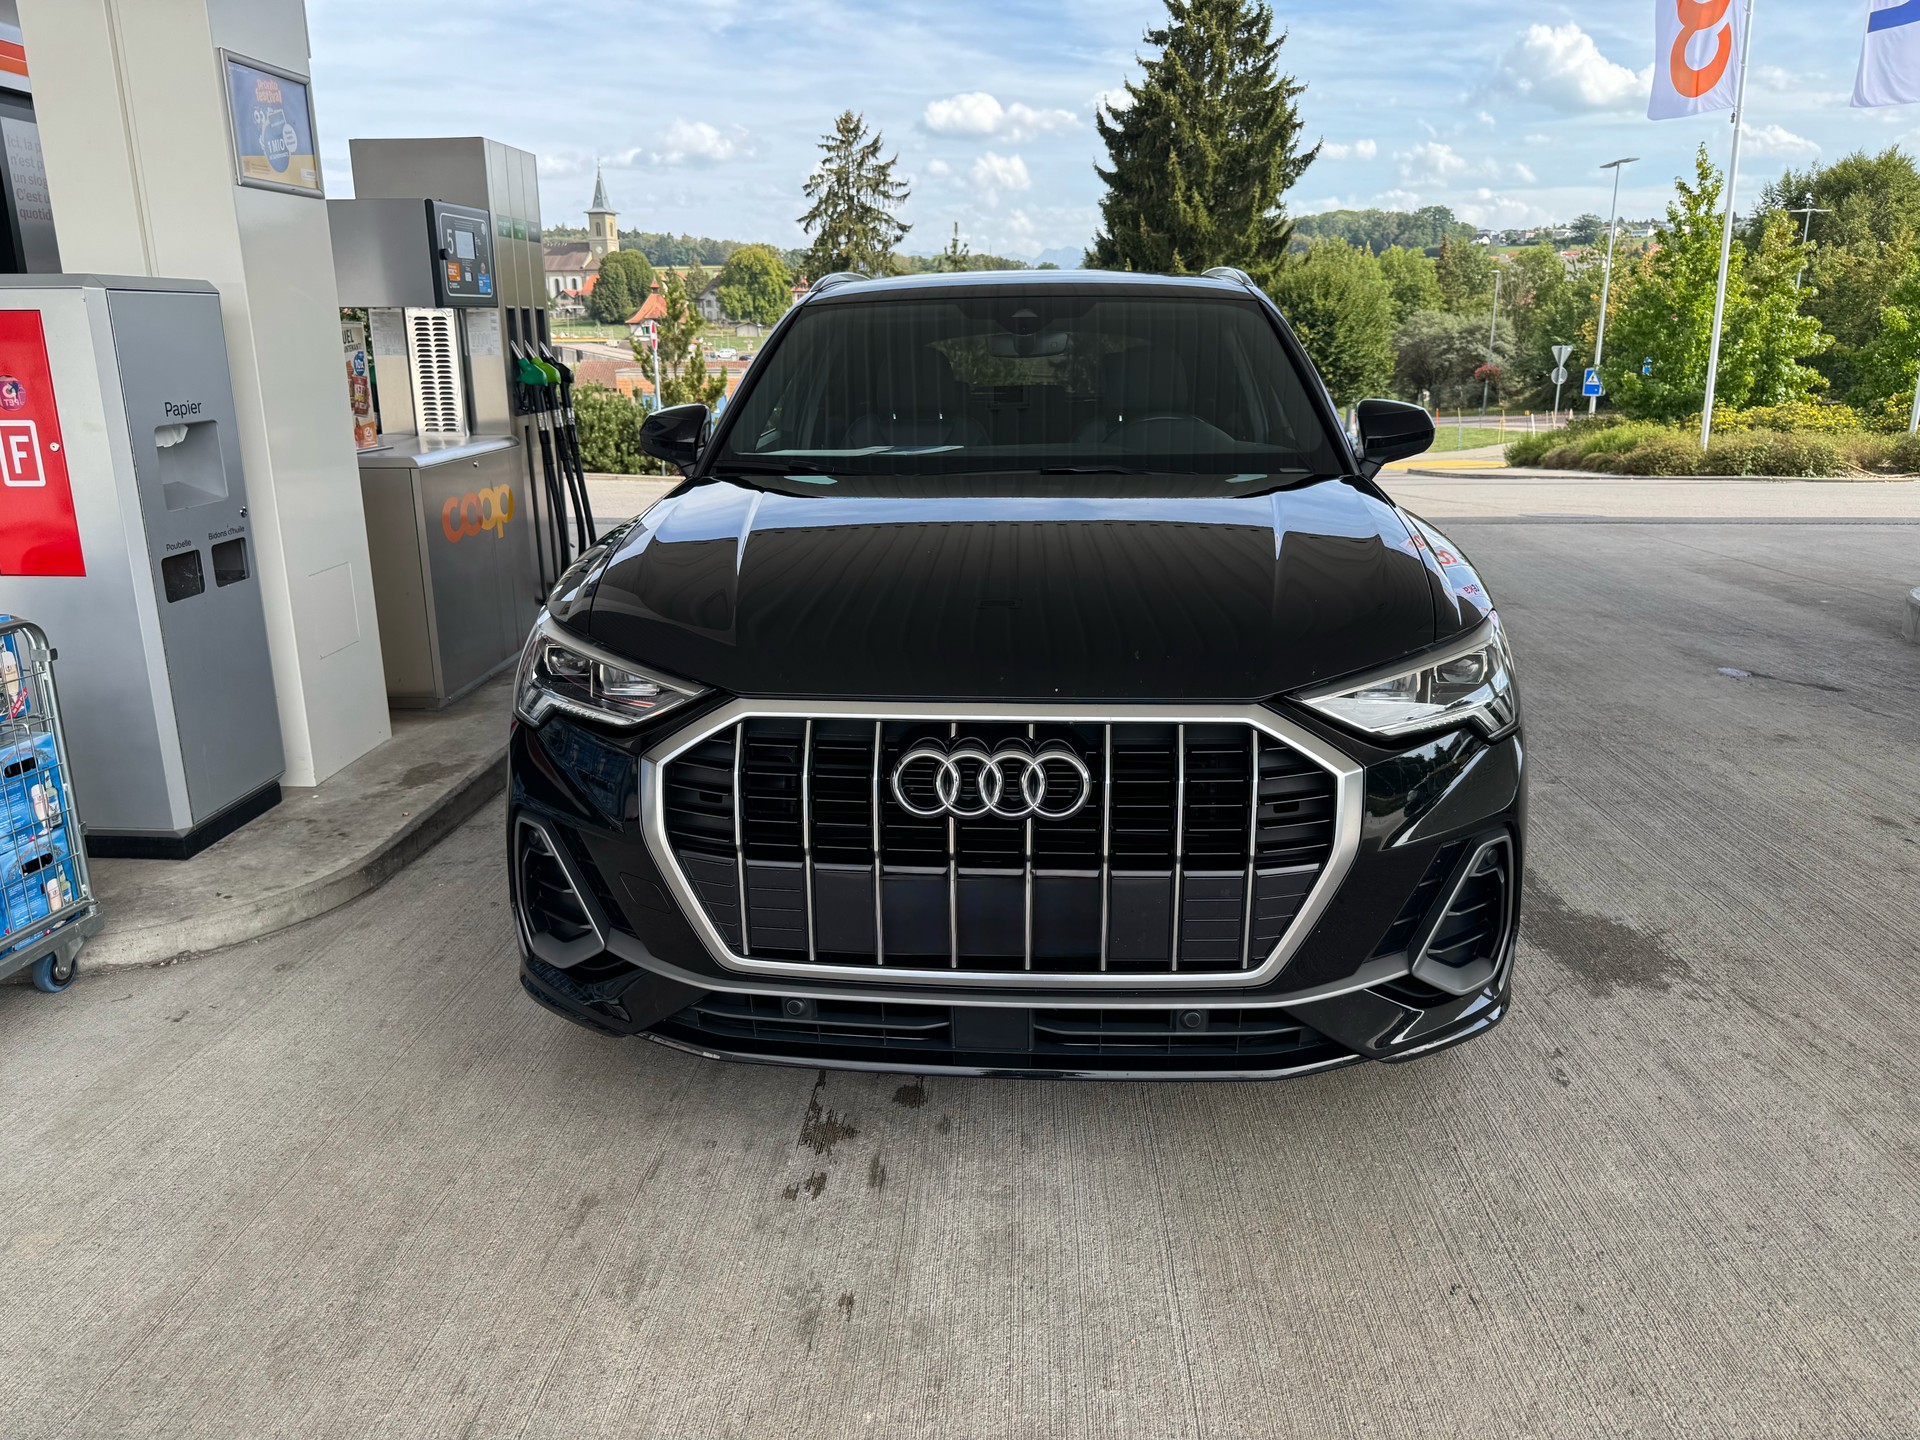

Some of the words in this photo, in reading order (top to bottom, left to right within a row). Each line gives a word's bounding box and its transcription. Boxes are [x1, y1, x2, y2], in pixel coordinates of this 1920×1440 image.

[255, 87, 282, 104] festival
[10, 153, 36, 169] n'est
[13, 172, 27, 184] un
[28, 173, 48, 190] slog
[16, 187, 43, 203] C'est
[446, 228, 454, 255] 5
[164, 400, 202, 419] Papier
[8, 435, 30, 474] F
[441, 482, 515, 543] coop
[208, 530, 227, 541] Bidons
[228, 525, 245, 536] d'huile
[165, 539, 192, 552] Poubelle
